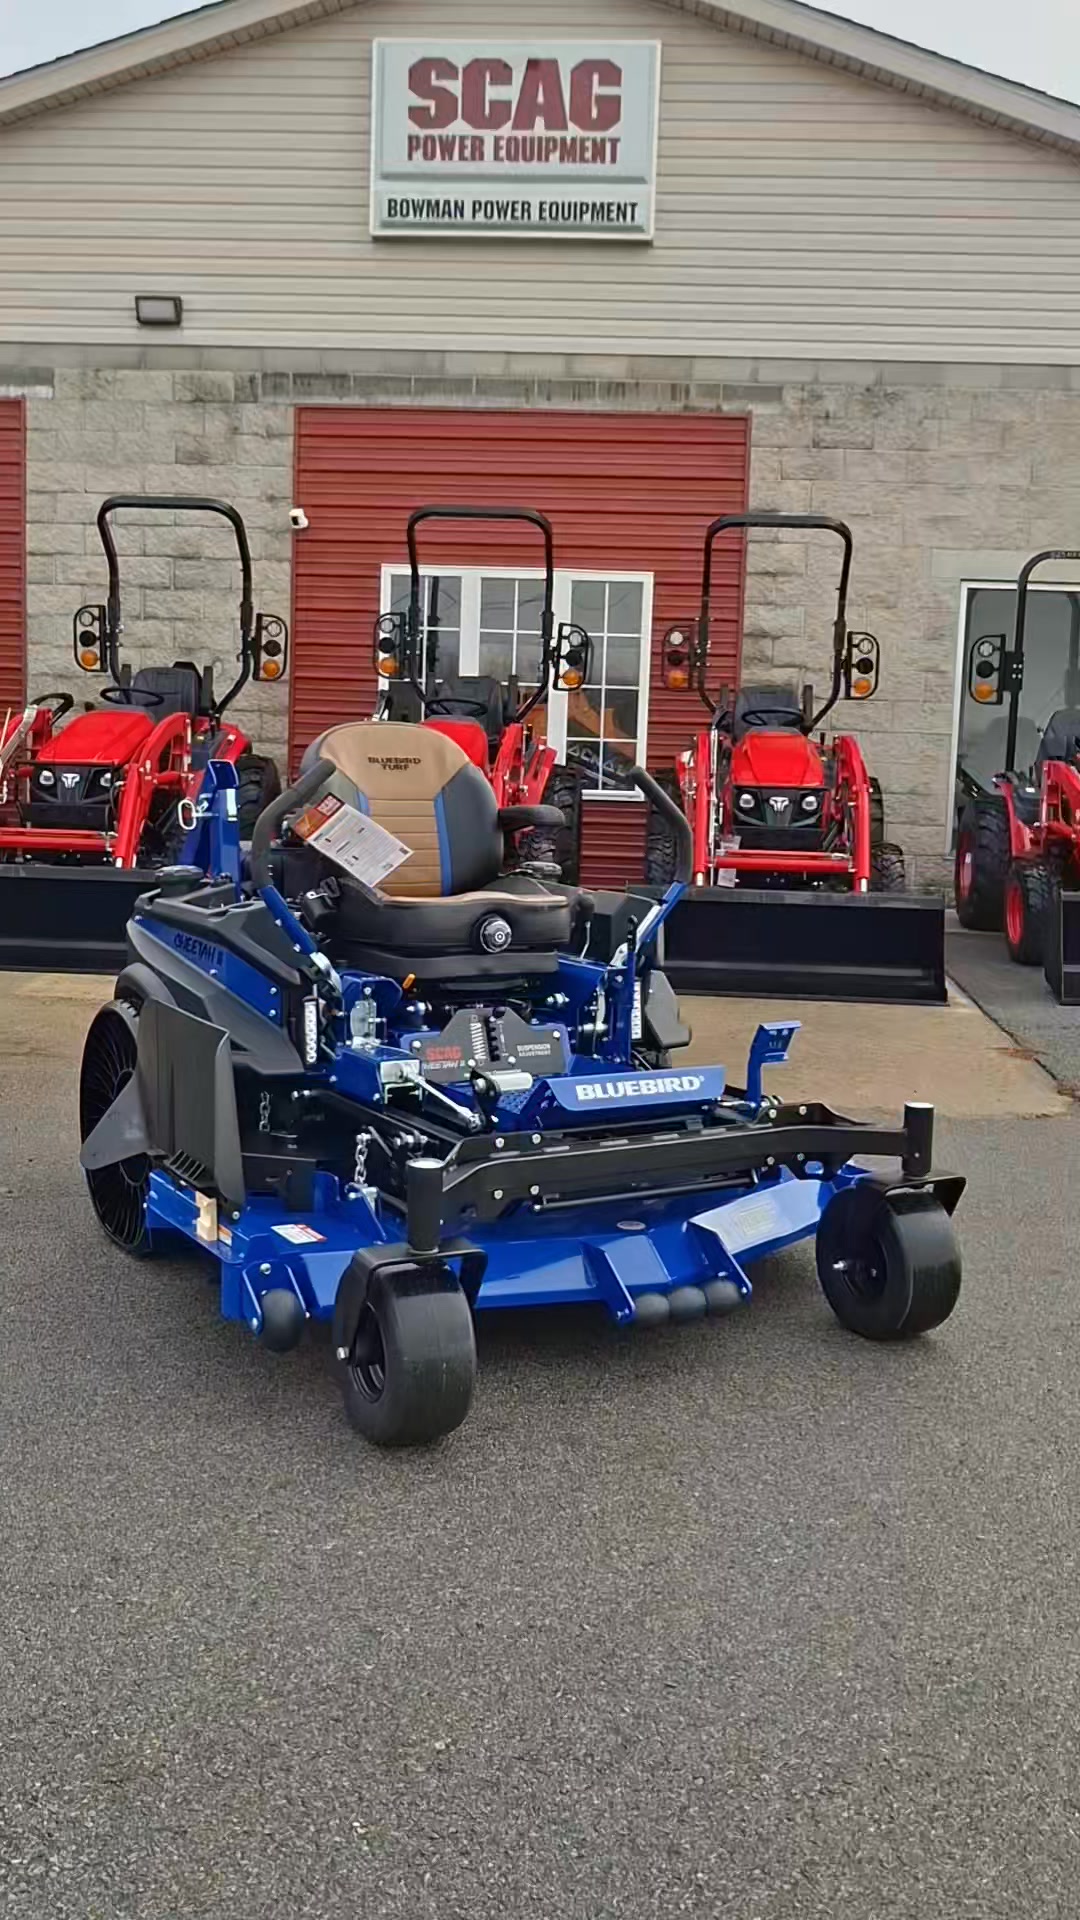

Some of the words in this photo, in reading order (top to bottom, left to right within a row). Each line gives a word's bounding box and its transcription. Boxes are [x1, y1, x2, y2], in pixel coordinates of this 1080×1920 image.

[408, 57, 622, 132] SCAG
[407, 134, 485, 162] POWER
[493, 136, 621, 165] EQUIPMENT
[387, 198, 465, 221] BOWMAN
[471, 200, 532, 222] POWER
[538, 201, 638, 224] EQUIPMENT
[367, 756, 421, 764] BLUEBIRD
[381, 763, 410, 771] TURF
[174, 932, 217, 964] CHEETAH
[575, 1075, 703, 1101] BLUEBIRD
